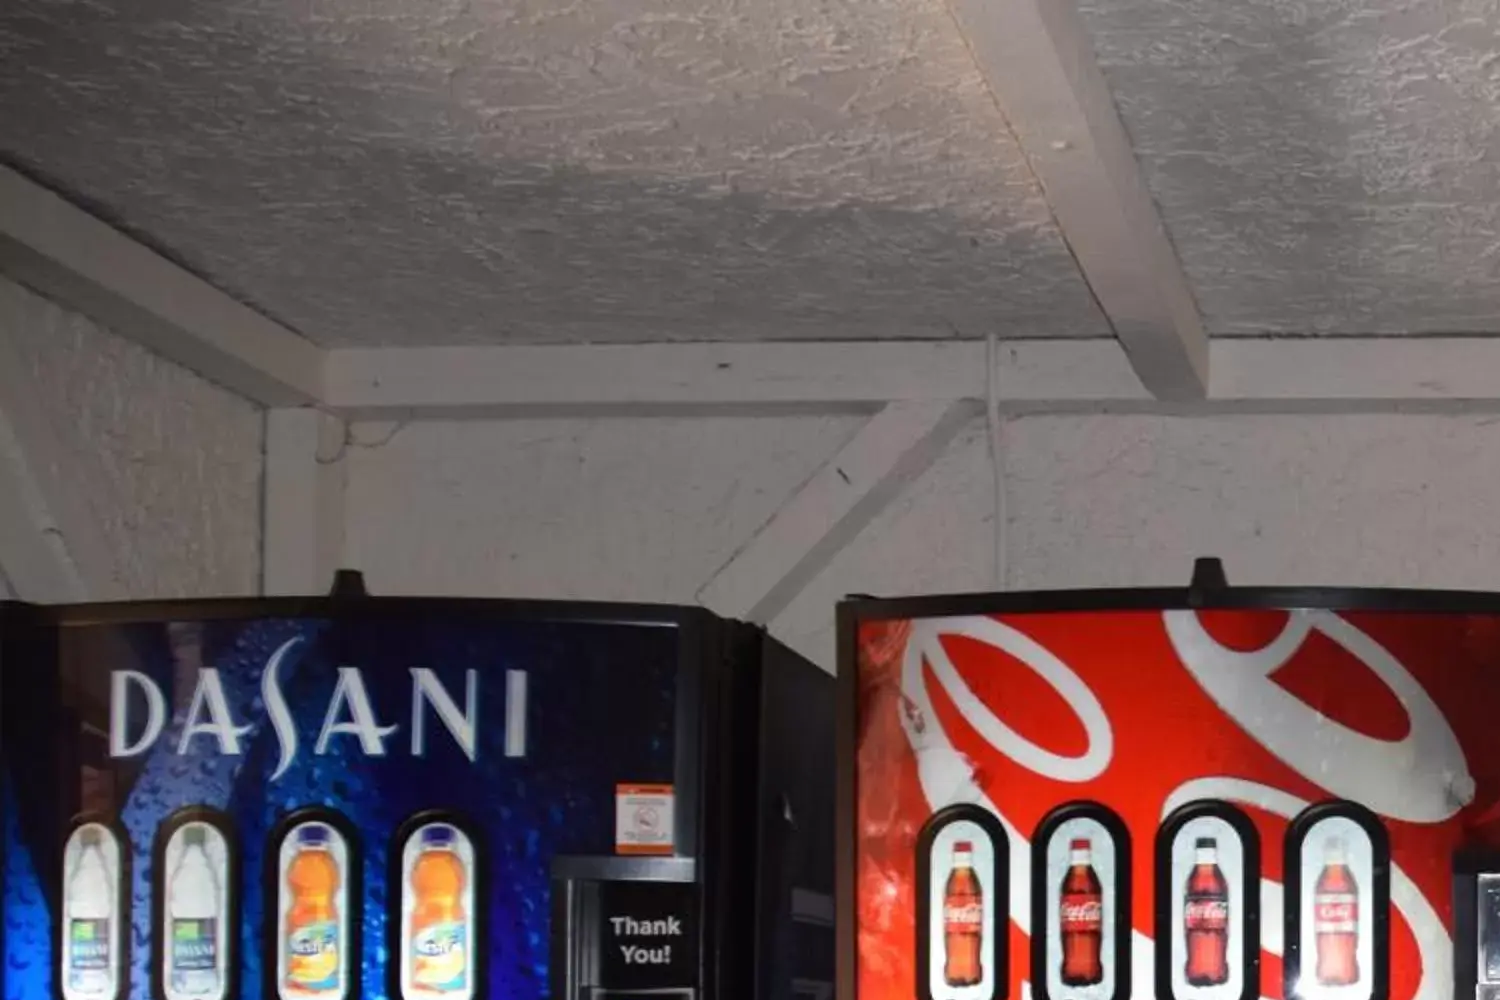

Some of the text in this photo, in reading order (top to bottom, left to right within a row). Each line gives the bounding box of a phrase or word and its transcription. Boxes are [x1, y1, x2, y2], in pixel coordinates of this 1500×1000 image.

[108, 636, 527, 782] DASANI
[609, 916, 682, 936] Thank
[620, 945, 671, 964] You!
